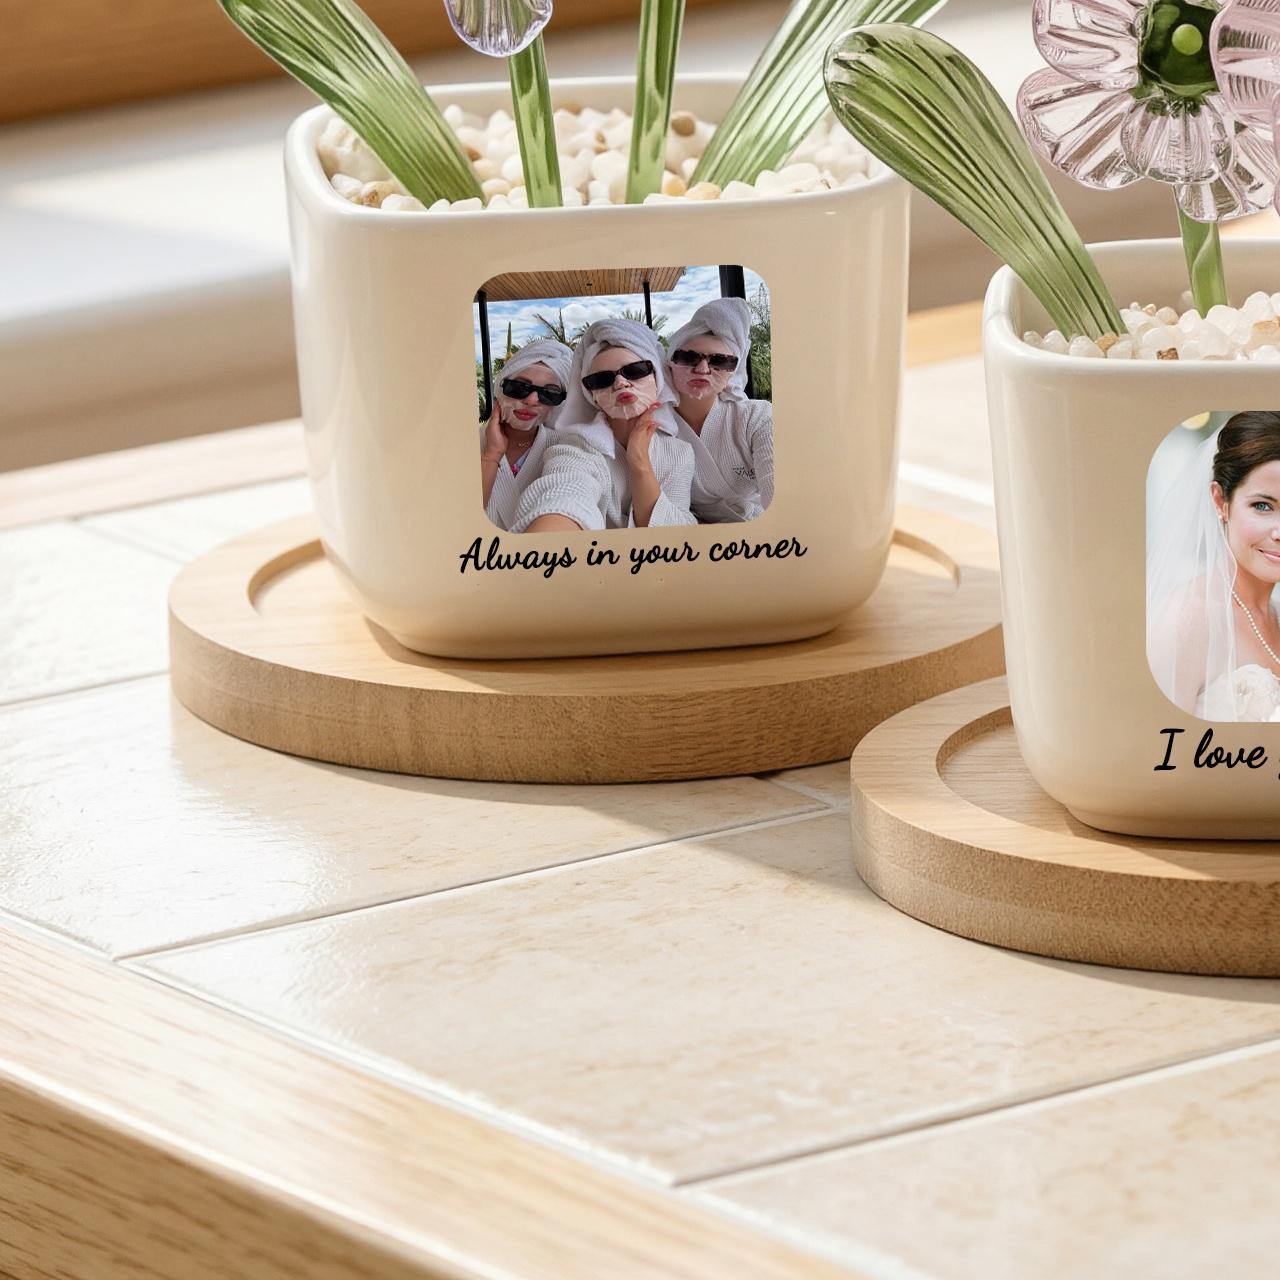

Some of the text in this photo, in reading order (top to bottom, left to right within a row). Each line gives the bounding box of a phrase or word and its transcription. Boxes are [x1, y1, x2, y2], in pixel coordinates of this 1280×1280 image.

[459, 536, 808, 579] Always in your corner
[1153, 728, 1186, 772] I
[1193, 727, 1269, 770] love
